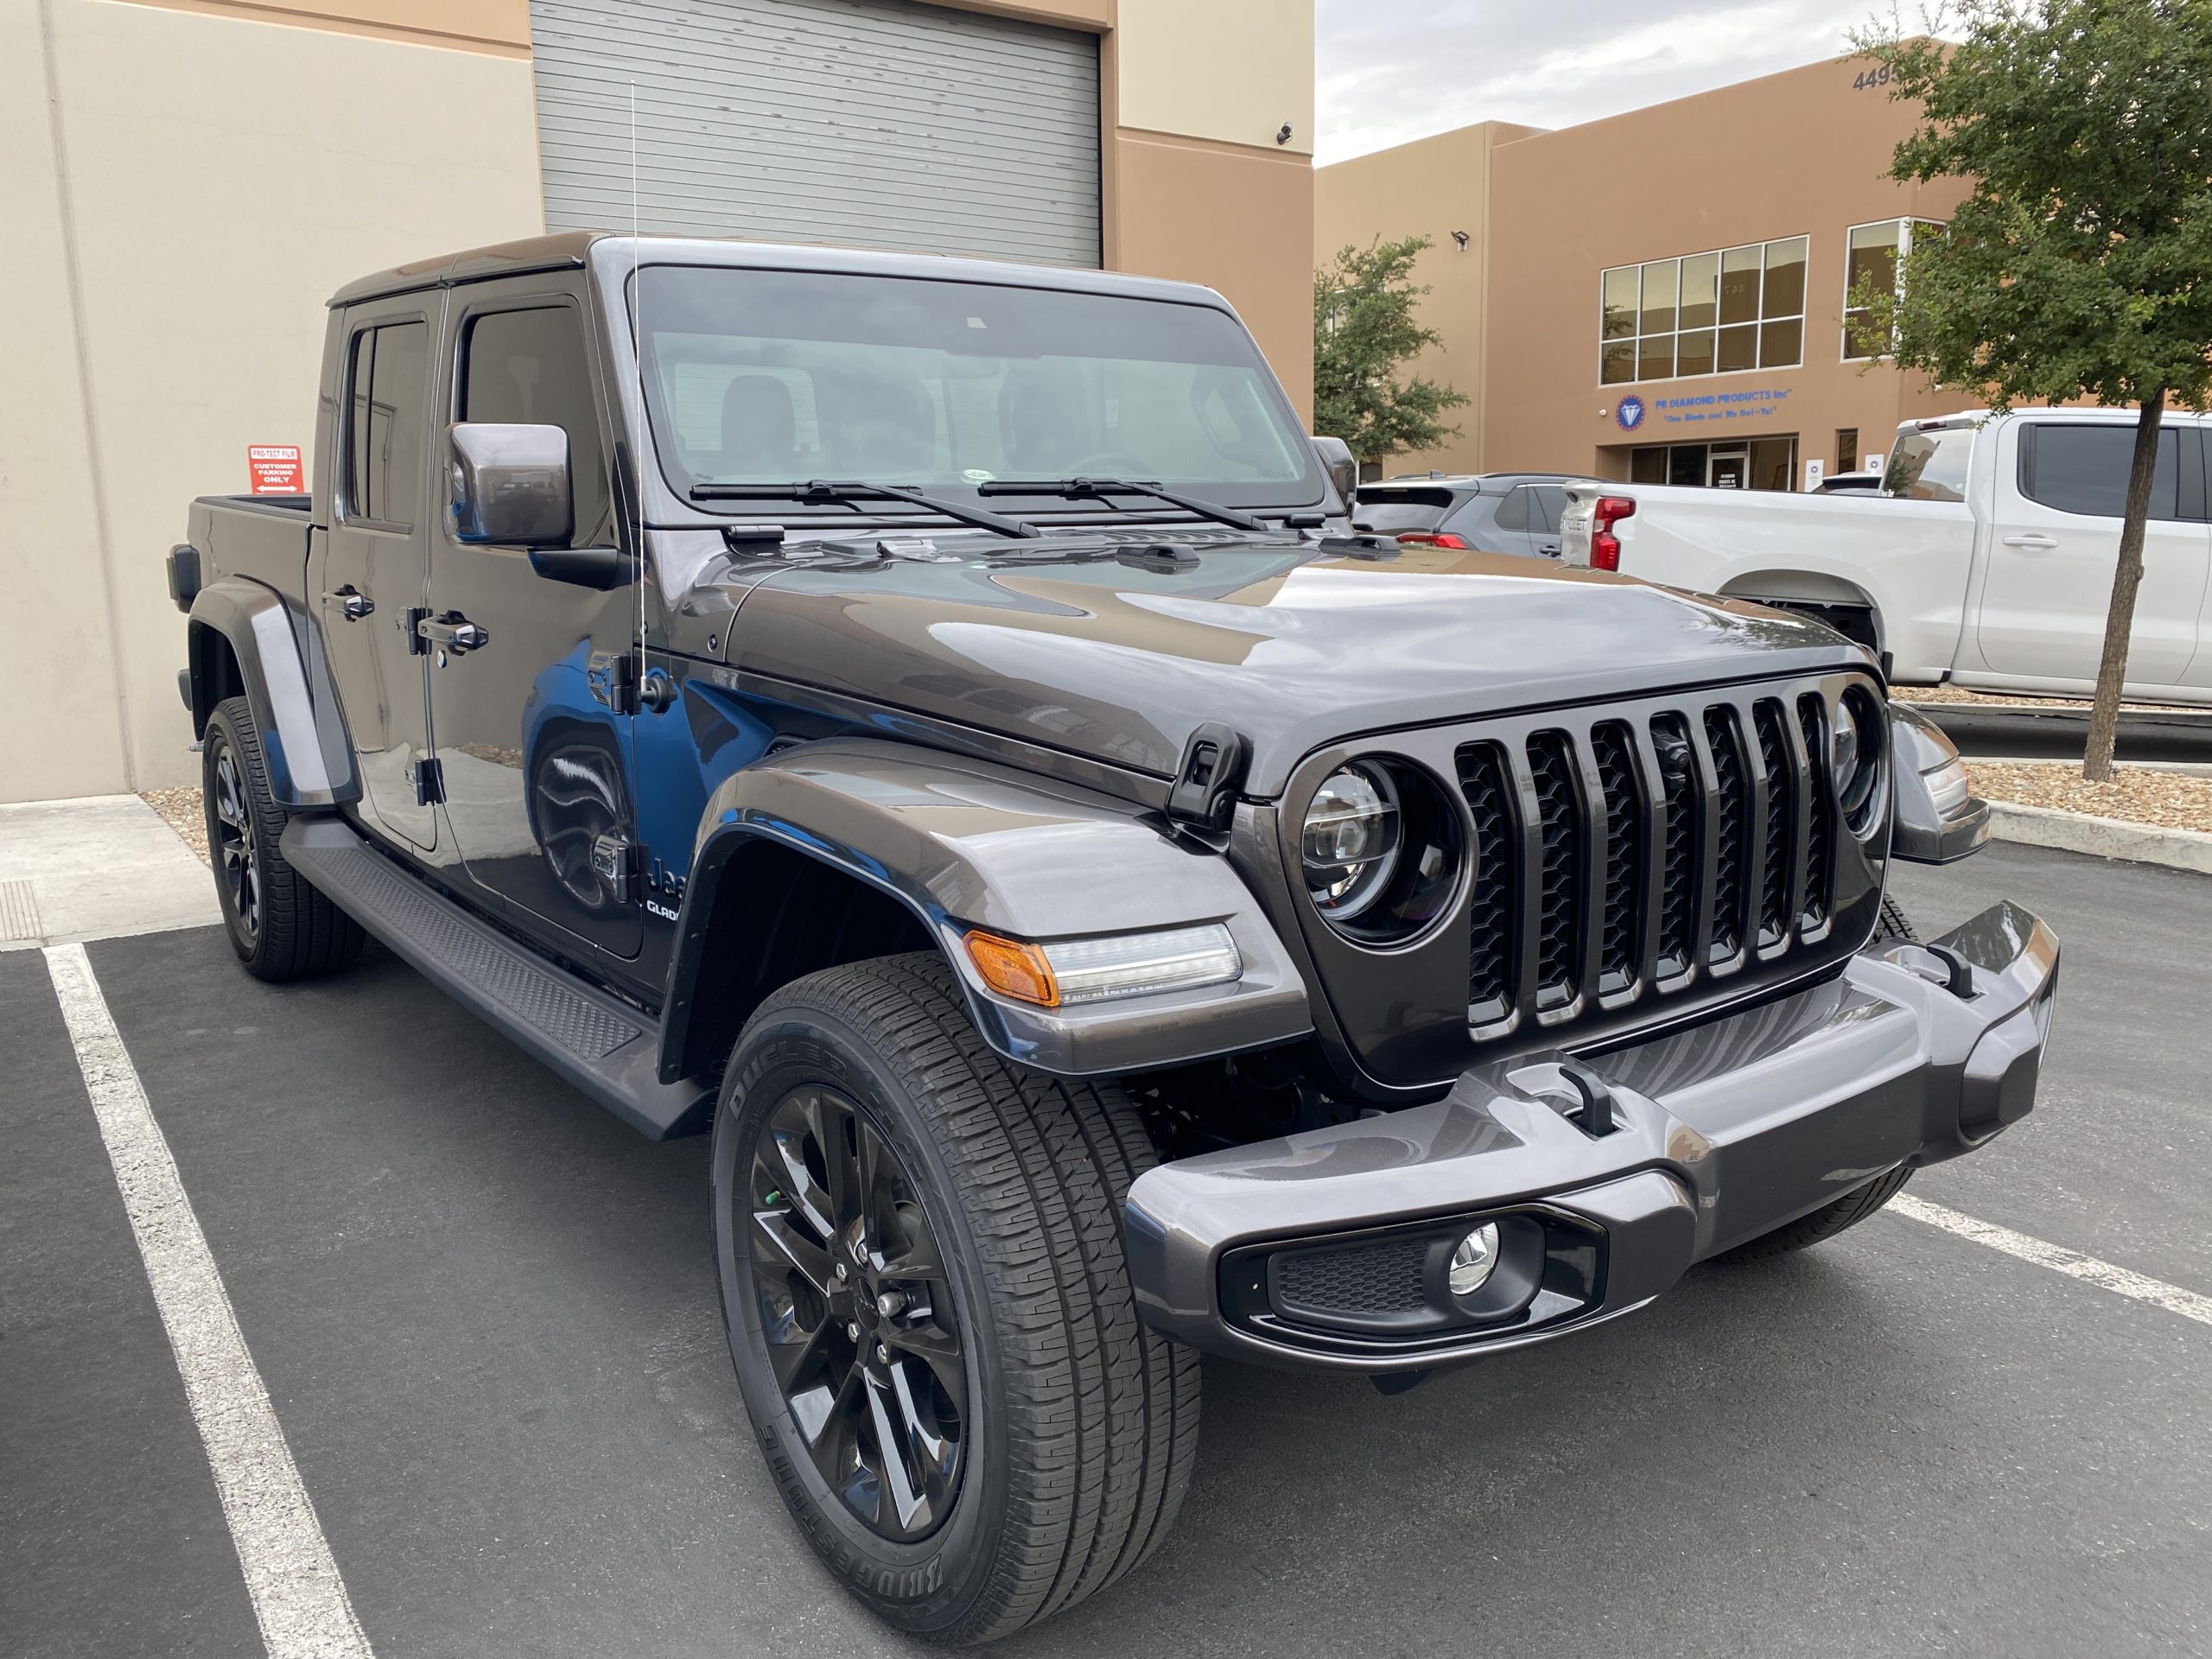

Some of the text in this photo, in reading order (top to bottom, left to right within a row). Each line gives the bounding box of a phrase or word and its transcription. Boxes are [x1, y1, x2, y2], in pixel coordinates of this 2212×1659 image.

[1670, 395, 1715, 408] DIAMOND
[1718, 391, 1771, 404] PRODUCTS
[728, 1040, 848, 1122] DUELER
[758, 1424, 944, 1599] BRIDGESTONE
